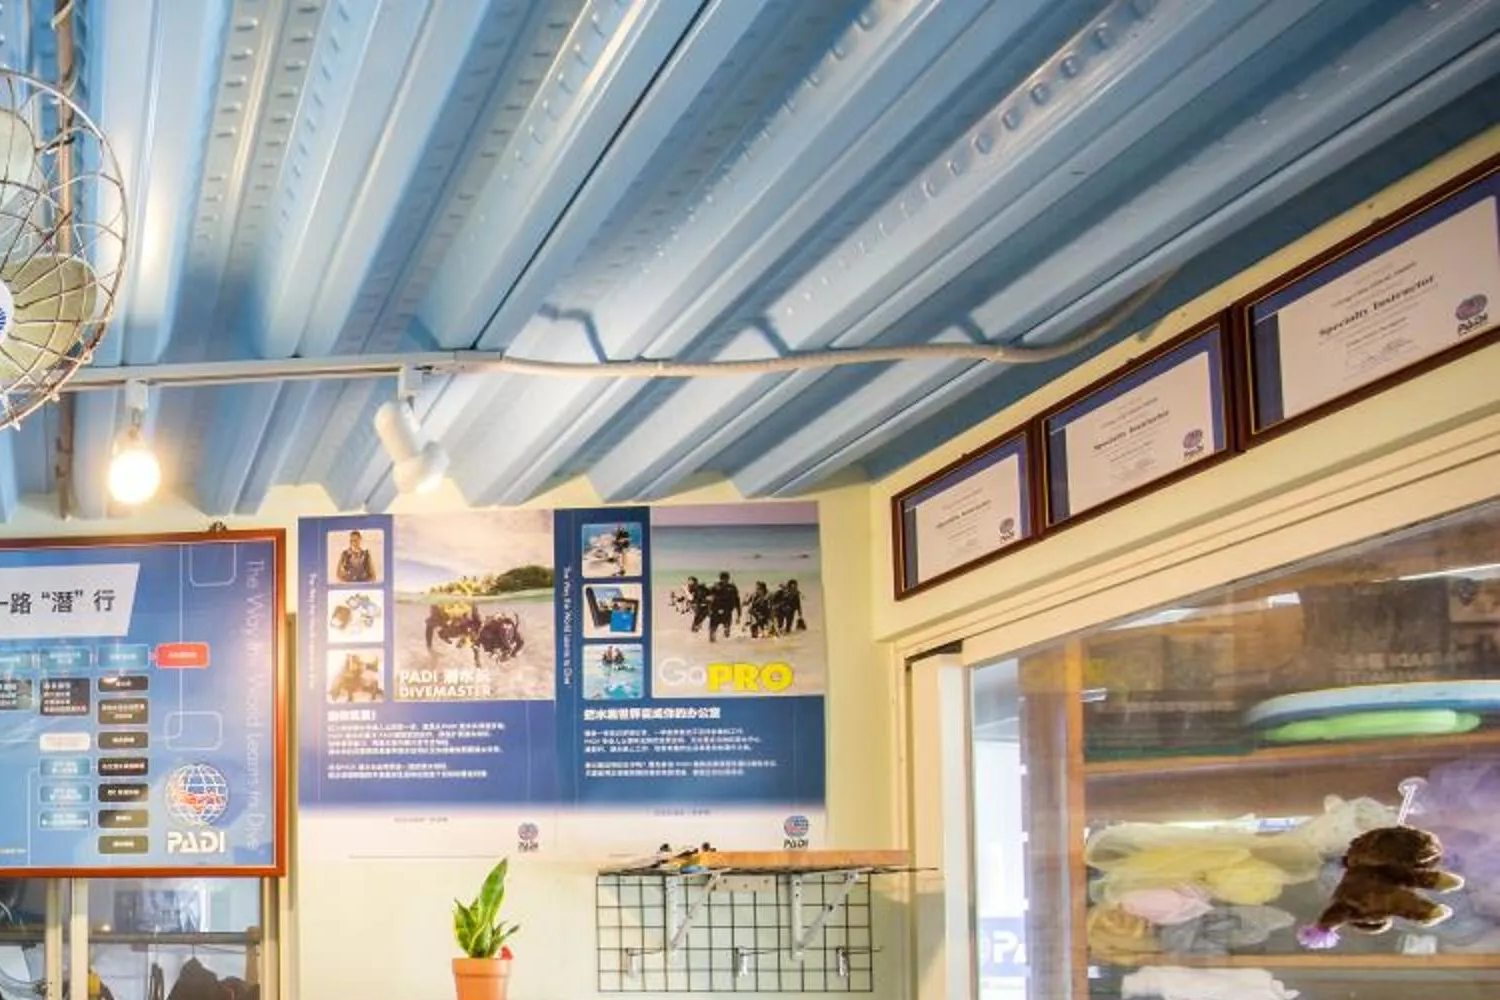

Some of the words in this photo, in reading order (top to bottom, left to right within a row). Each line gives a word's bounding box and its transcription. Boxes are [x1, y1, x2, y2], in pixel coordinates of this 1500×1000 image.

[94, 589, 116, 613] 行
[400, 669, 437, 683] PADI
[400, 684, 491, 697] DIVEMASTER
[167, 831, 225, 853] PADI
